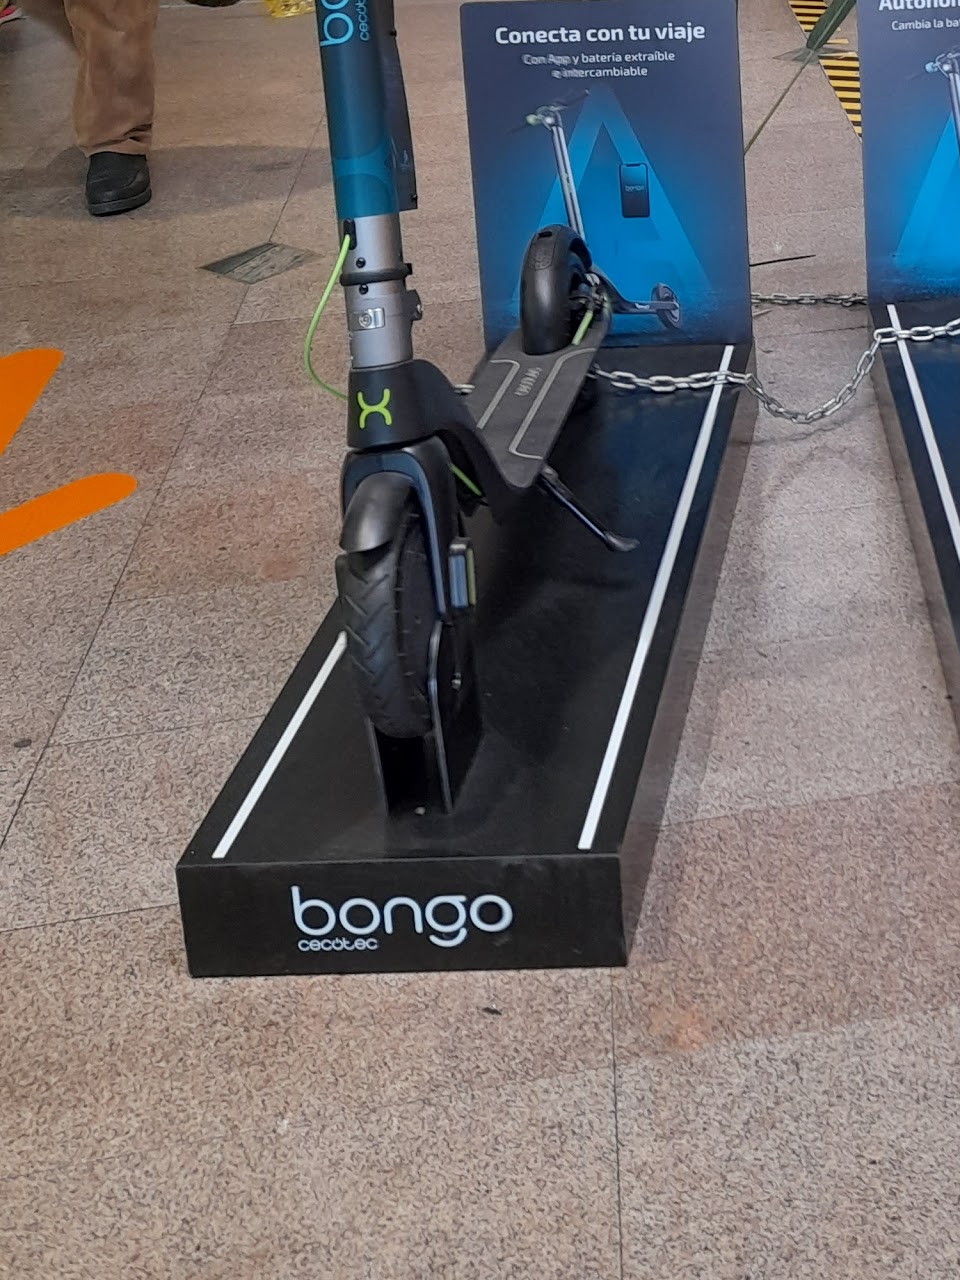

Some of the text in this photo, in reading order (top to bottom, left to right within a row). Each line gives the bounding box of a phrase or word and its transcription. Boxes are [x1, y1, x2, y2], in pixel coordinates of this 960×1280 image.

[891, 19, 931, 31] Cambia
[933, 18, 944, 29] la
[495, 22, 706, 45] Conecta con tu viaje
[522, 51, 676, 66] Con App y batería extraíble
[552, 66, 648, 79] e intercambiable
[290, 885, 513, 948] bongo
[298, 937, 378, 952] cecotec
